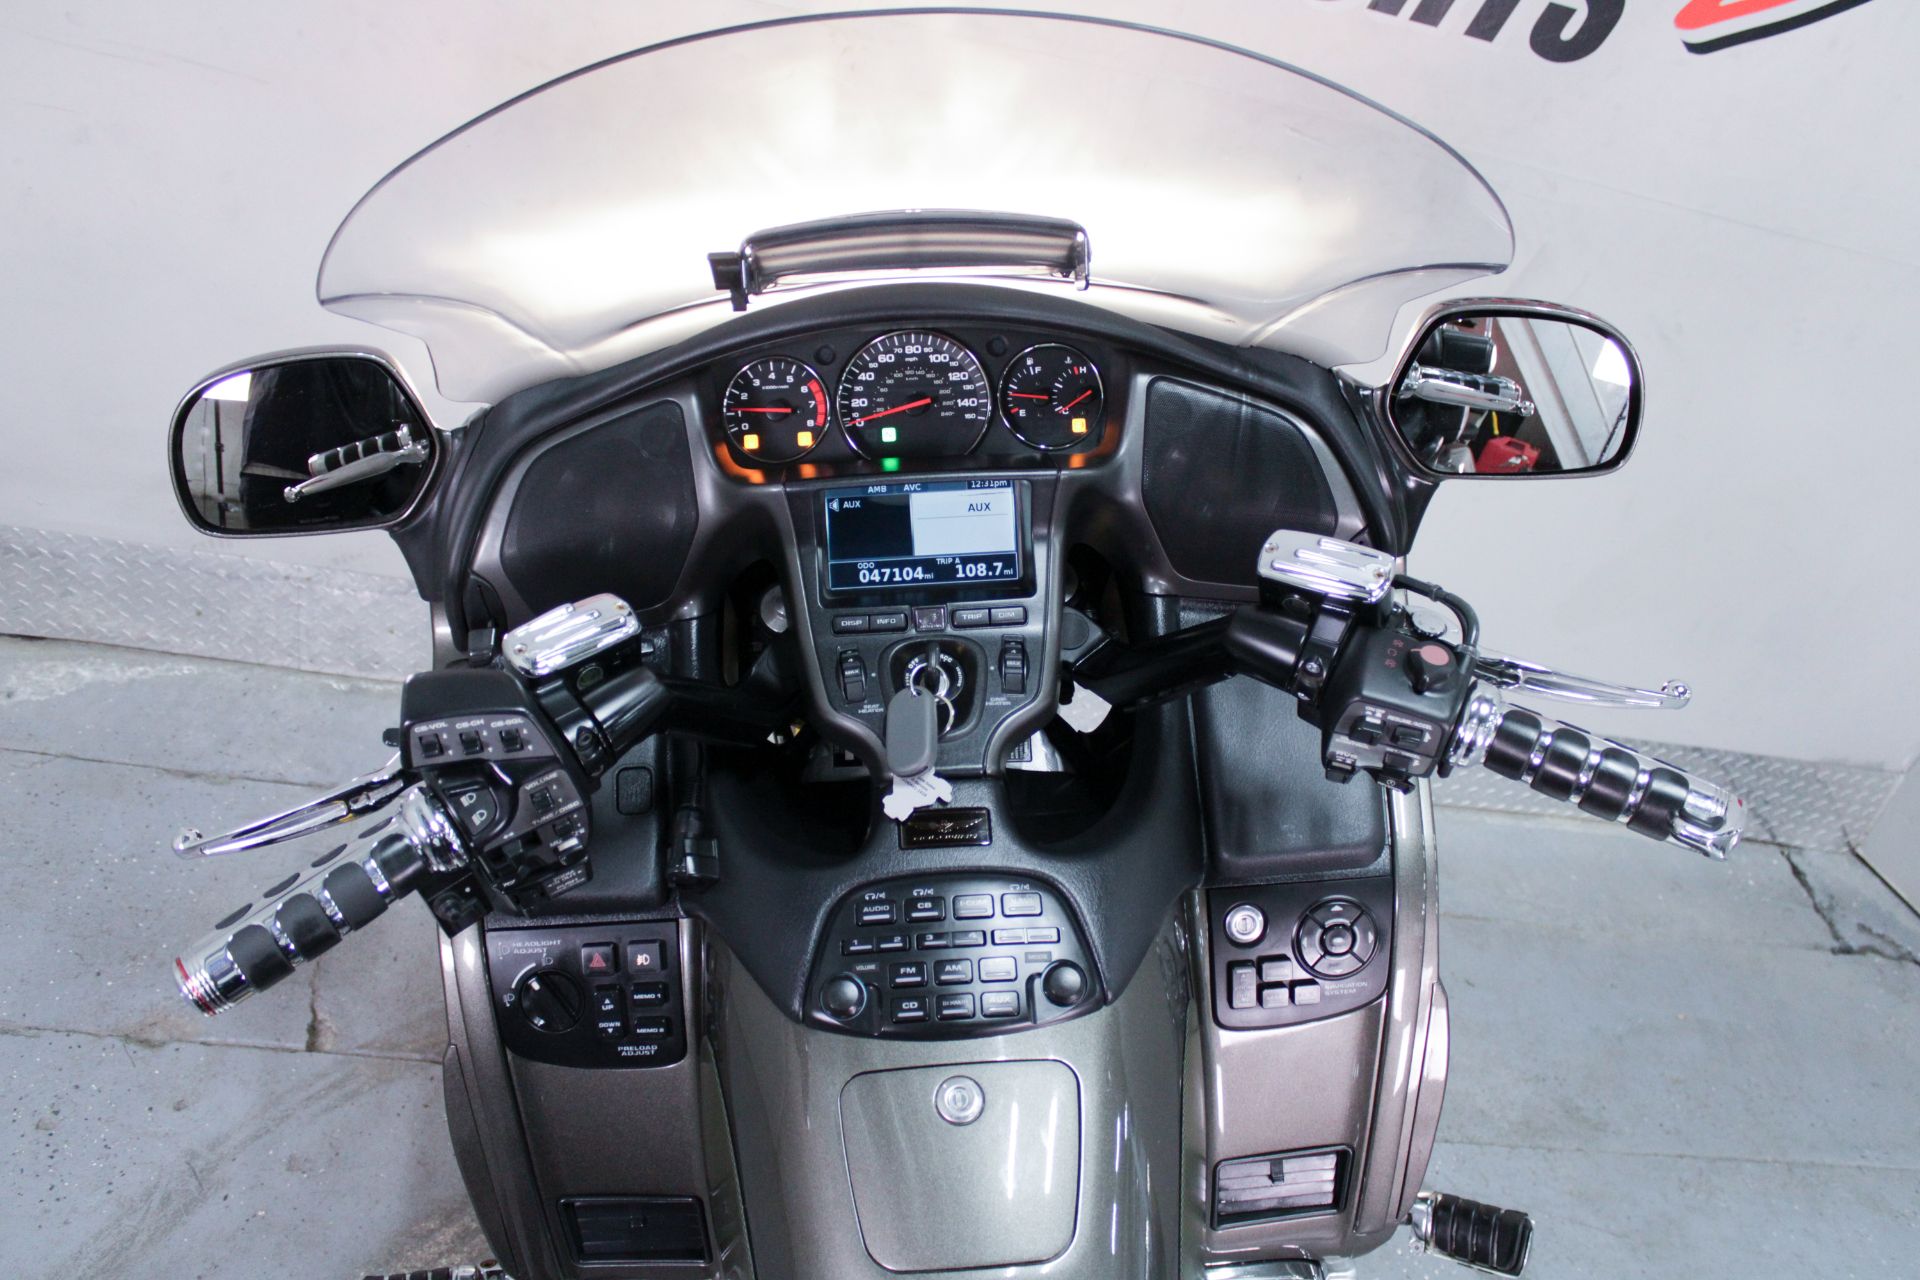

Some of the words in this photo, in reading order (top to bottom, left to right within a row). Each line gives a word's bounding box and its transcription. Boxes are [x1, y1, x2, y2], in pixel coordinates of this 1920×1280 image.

[905, 345, 921, 354] 80
[878, 354, 895, 362] 60
[929, 354, 950, 362] 100
[858, 372, 874, 380] 40
[948, 372, 968, 380] 120
[851, 398, 868, 407] 20
[957, 398, 978, 406] 140
[856, 418, 864, 427] 0
[868, 485, 886, 493] AMB
[904, 484, 921, 492] AVC
[843, 500, 861, 508] AUX
[968, 502, 991, 512] AUX
[859, 566, 924, 583] 047104
[956, 562, 1003, 578] 108.7
[940, 654, 953, 663] ACC
[525, 772, 558, 790] VOLUME
[512, 940, 561, 948] HEADLIGHT
